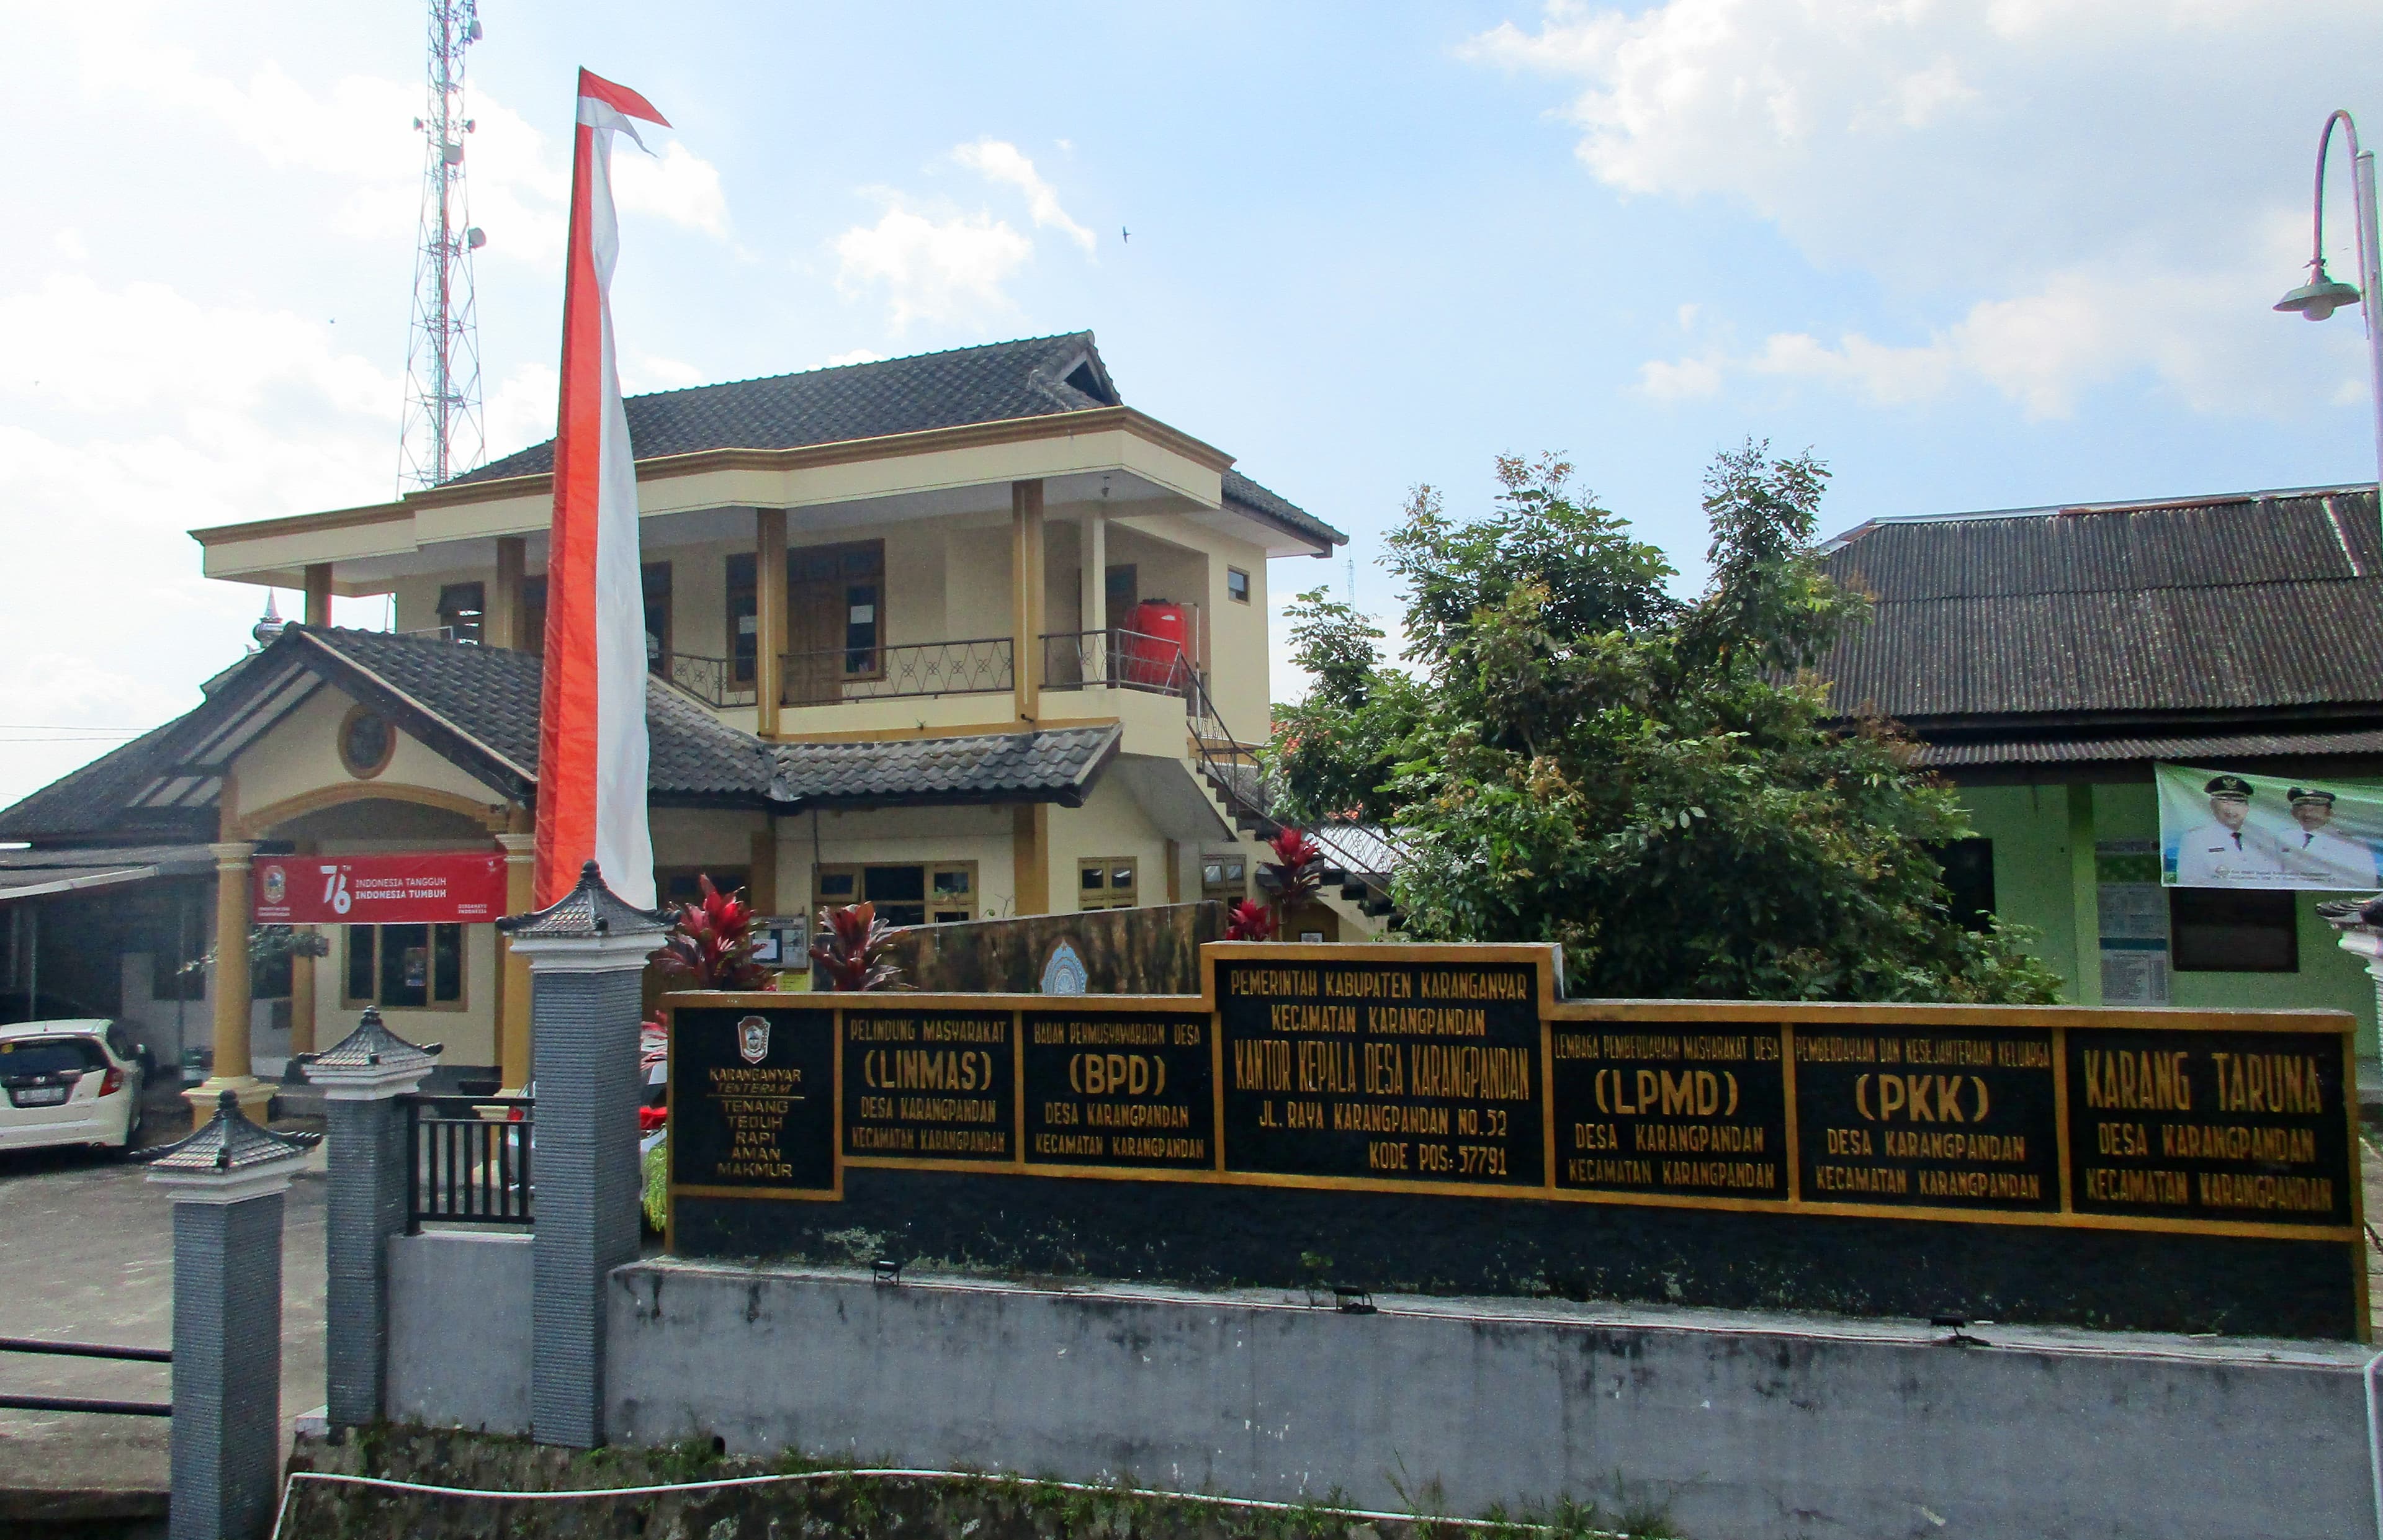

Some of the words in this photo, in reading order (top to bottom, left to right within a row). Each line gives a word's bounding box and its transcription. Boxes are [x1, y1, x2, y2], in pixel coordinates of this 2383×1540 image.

[320, 865, 351, 915] 76
[356, 878, 403, 888] INDONESIA
[405, 877, 447, 886] TANGGUH
[356, 890, 406, 900] INDONESIA
[409, 889, 447, 898] TUMBUH
[1231, 970, 1317, 996] PEMERINTAH
[1325, 971, 1411, 998] KABUPATEN
[1420, 972, 1527, 1000] KARANGANYAR
[850, 1019, 915, 1041] PELINDUNG
[923, 1020, 1007, 1042] MASYARAKAT
[1271, 1004, 1356, 1032] KECAMATAN
[1368, 1006, 1486, 1036] KARANGPANDAN
[1034, 1023, 1064, 1044] BADAN
[1070, 1023, 1165, 1045] PERMUSYAWARATAN
[1174, 1024, 1200, 1045] DESA
[1555, 1034, 1599, 1059] LEMBAGA
[1604, 1034, 1679, 1060] PEMBERDAYAAN
[1683, 1036, 1747, 1060] MASYARAKAT
[1753, 1037, 1779, 1060] DESA
[1878, 1037, 1901, 1063] DAN
[709, 1068, 801, 1082] KARANGANYAR
[864, 1050, 992, 1091] (LINMAS)
[1069, 1054, 1165, 1096] (BPD)
[1235, 1039, 1291, 1091] KANTOR
[1298, 1041, 1357, 1093] KEPALA
[1365, 1042, 1404, 1096] DESA
[1411, 1044, 1530, 1100] KARANGPANDAN
[2083, 1050, 2191, 1110] KARANG
[2211, 1052, 2322, 1114] TARUNA
[717, 1083, 792, 1094] TENTERAM
[1595, 1068, 1738, 1116] (LPMD)
[1856, 1073, 1989, 1122] (PKK)
[722, 1100, 789, 1114] TENANG
[861, 1096, 894, 1119] DESA
[900, 1098, 996, 1122] KARANGPANDAN
[1044, 1102, 1079, 1126] DESA
[1087, 1103, 1190, 1127] KARANGPANDAN
[1259, 1100, 1282, 1128] JL.
[1287, 1101, 1324, 1129] RAYA
[1334, 1103, 1448, 1135] KARANGPANDAN
[727, 1116, 783, 1129] TEDUH
[735, 1132, 775, 1145] RAPI
[852, 1127, 914, 1149] KECAMATAN
[920, 1129, 1005, 1152] KARANGPANDAN
[1035, 1133, 1103, 1155] KECAMATAN
[1113, 1137, 1205, 1158] KARANGPANDAN
[1575, 1123, 1618, 1150] DESA
[1635, 1124, 1764, 1152] KARANGPANDAN
[1827, 1128, 1872, 1156] DESA
[1885, 1130, 2026, 1162] KARANGPANDAN
[2098, 1122, 2148, 1156] DESA
[2162, 1124, 2316, 1163] KARANGPANDAN
[732, 1147, 781, 1161] AMAN
[1369, 1142, 1409, 1170] KODE
[1419, 1144, 1453, 1171] POS:
[1459, 1145, 1507, 1176] 57791
[717, 1163, 792, 1177] MAKMUR
[1569, 1158, 1652, 1184] KECAMATAN
[1663, 1160, 1775, 1189] KARANGPANDAN
[1816, 1166, 1907, 1194] KECAMATAN
[1918, 1170, 2040, 1199] KARANGPANDAN
[2085, 1168, 2189, 1205] KECAMATAN
[2199, 1171, 2333, 1212] KARANGPANDAN
